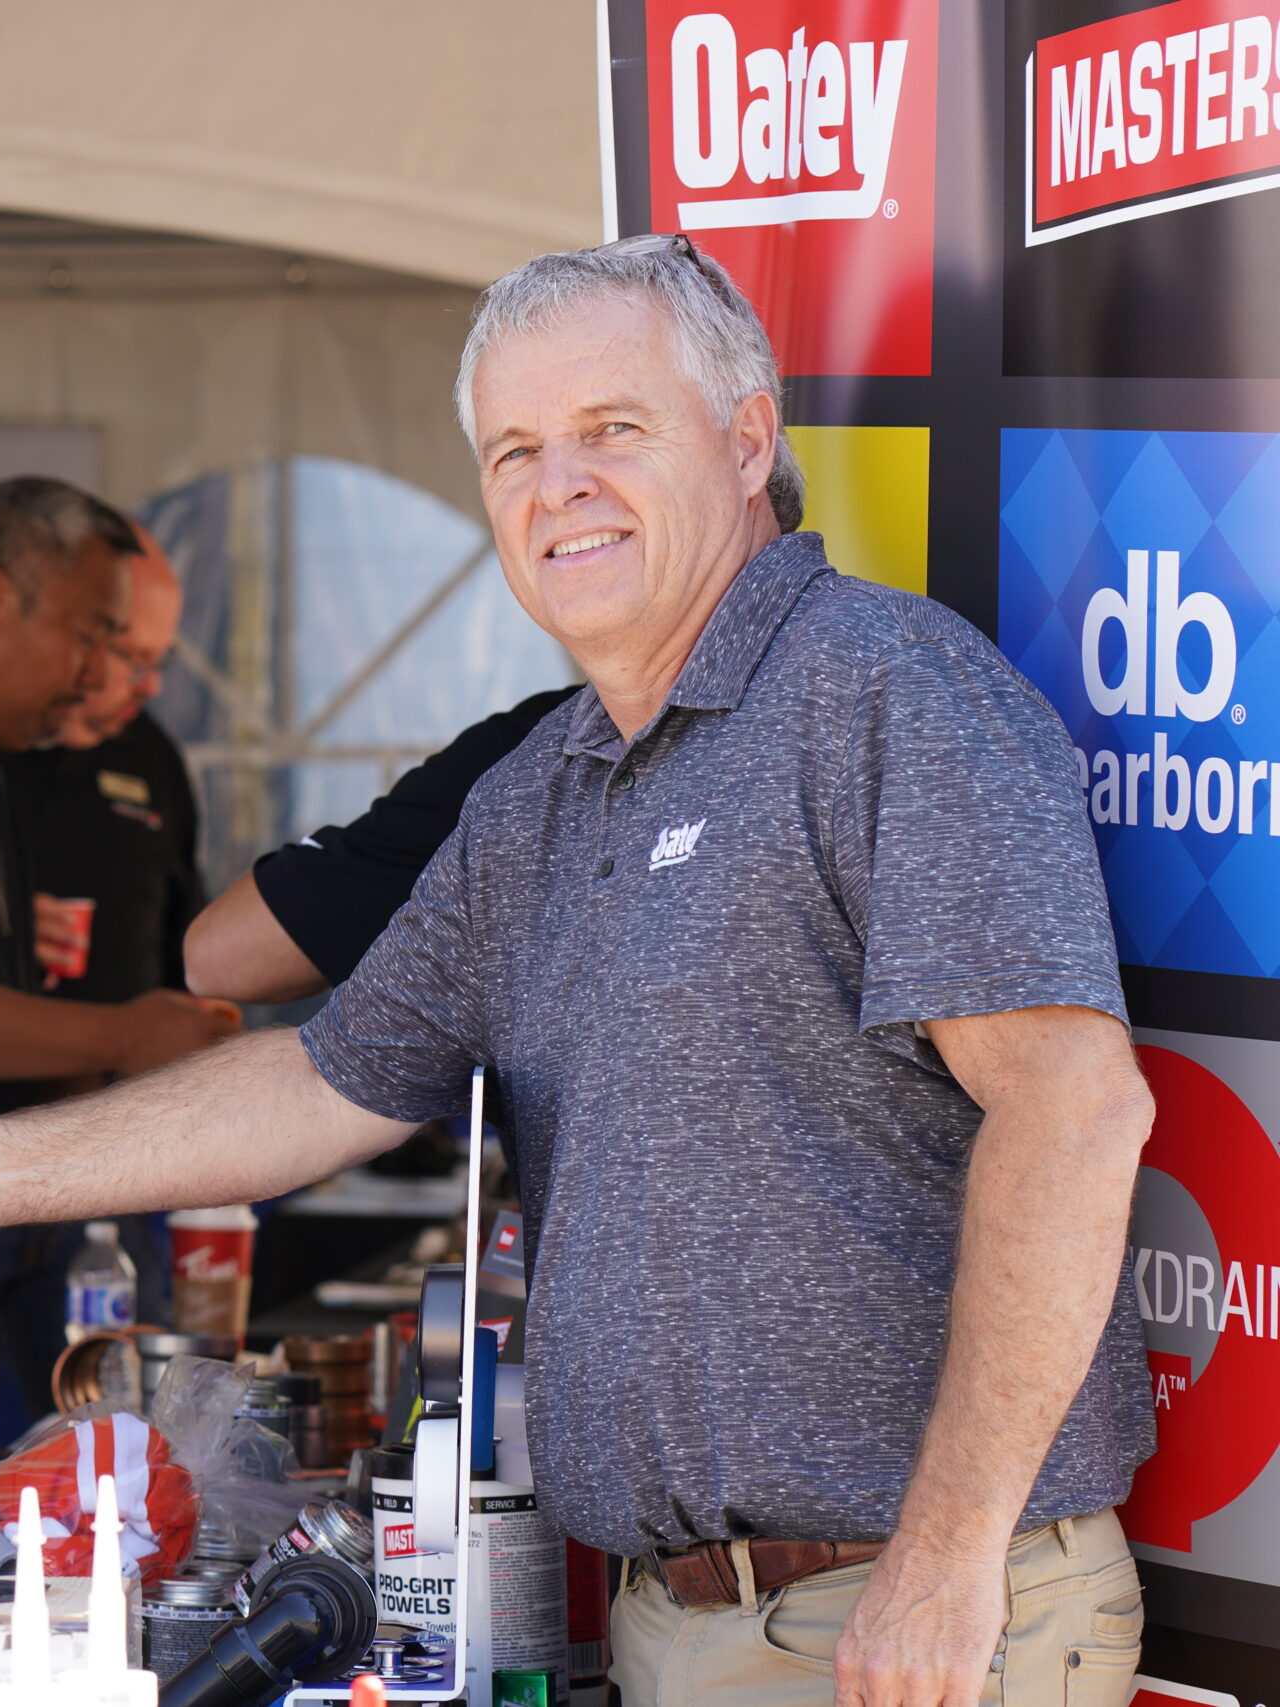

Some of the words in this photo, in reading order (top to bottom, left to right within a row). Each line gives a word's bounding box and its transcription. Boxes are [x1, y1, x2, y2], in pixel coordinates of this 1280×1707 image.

[1051, 14, 1280, 187] MASTER
[1082, 549, 1237, 722] db
[383, 1498, 398, 1509] FIELD
[485, 1499, 517, 1510] SERVICE
[385, 1528, 417, 1552] MAST
[380, 1573, 456, 1595] PRO-GRIT
[381, 1594, 451, 1615] TOWELS
